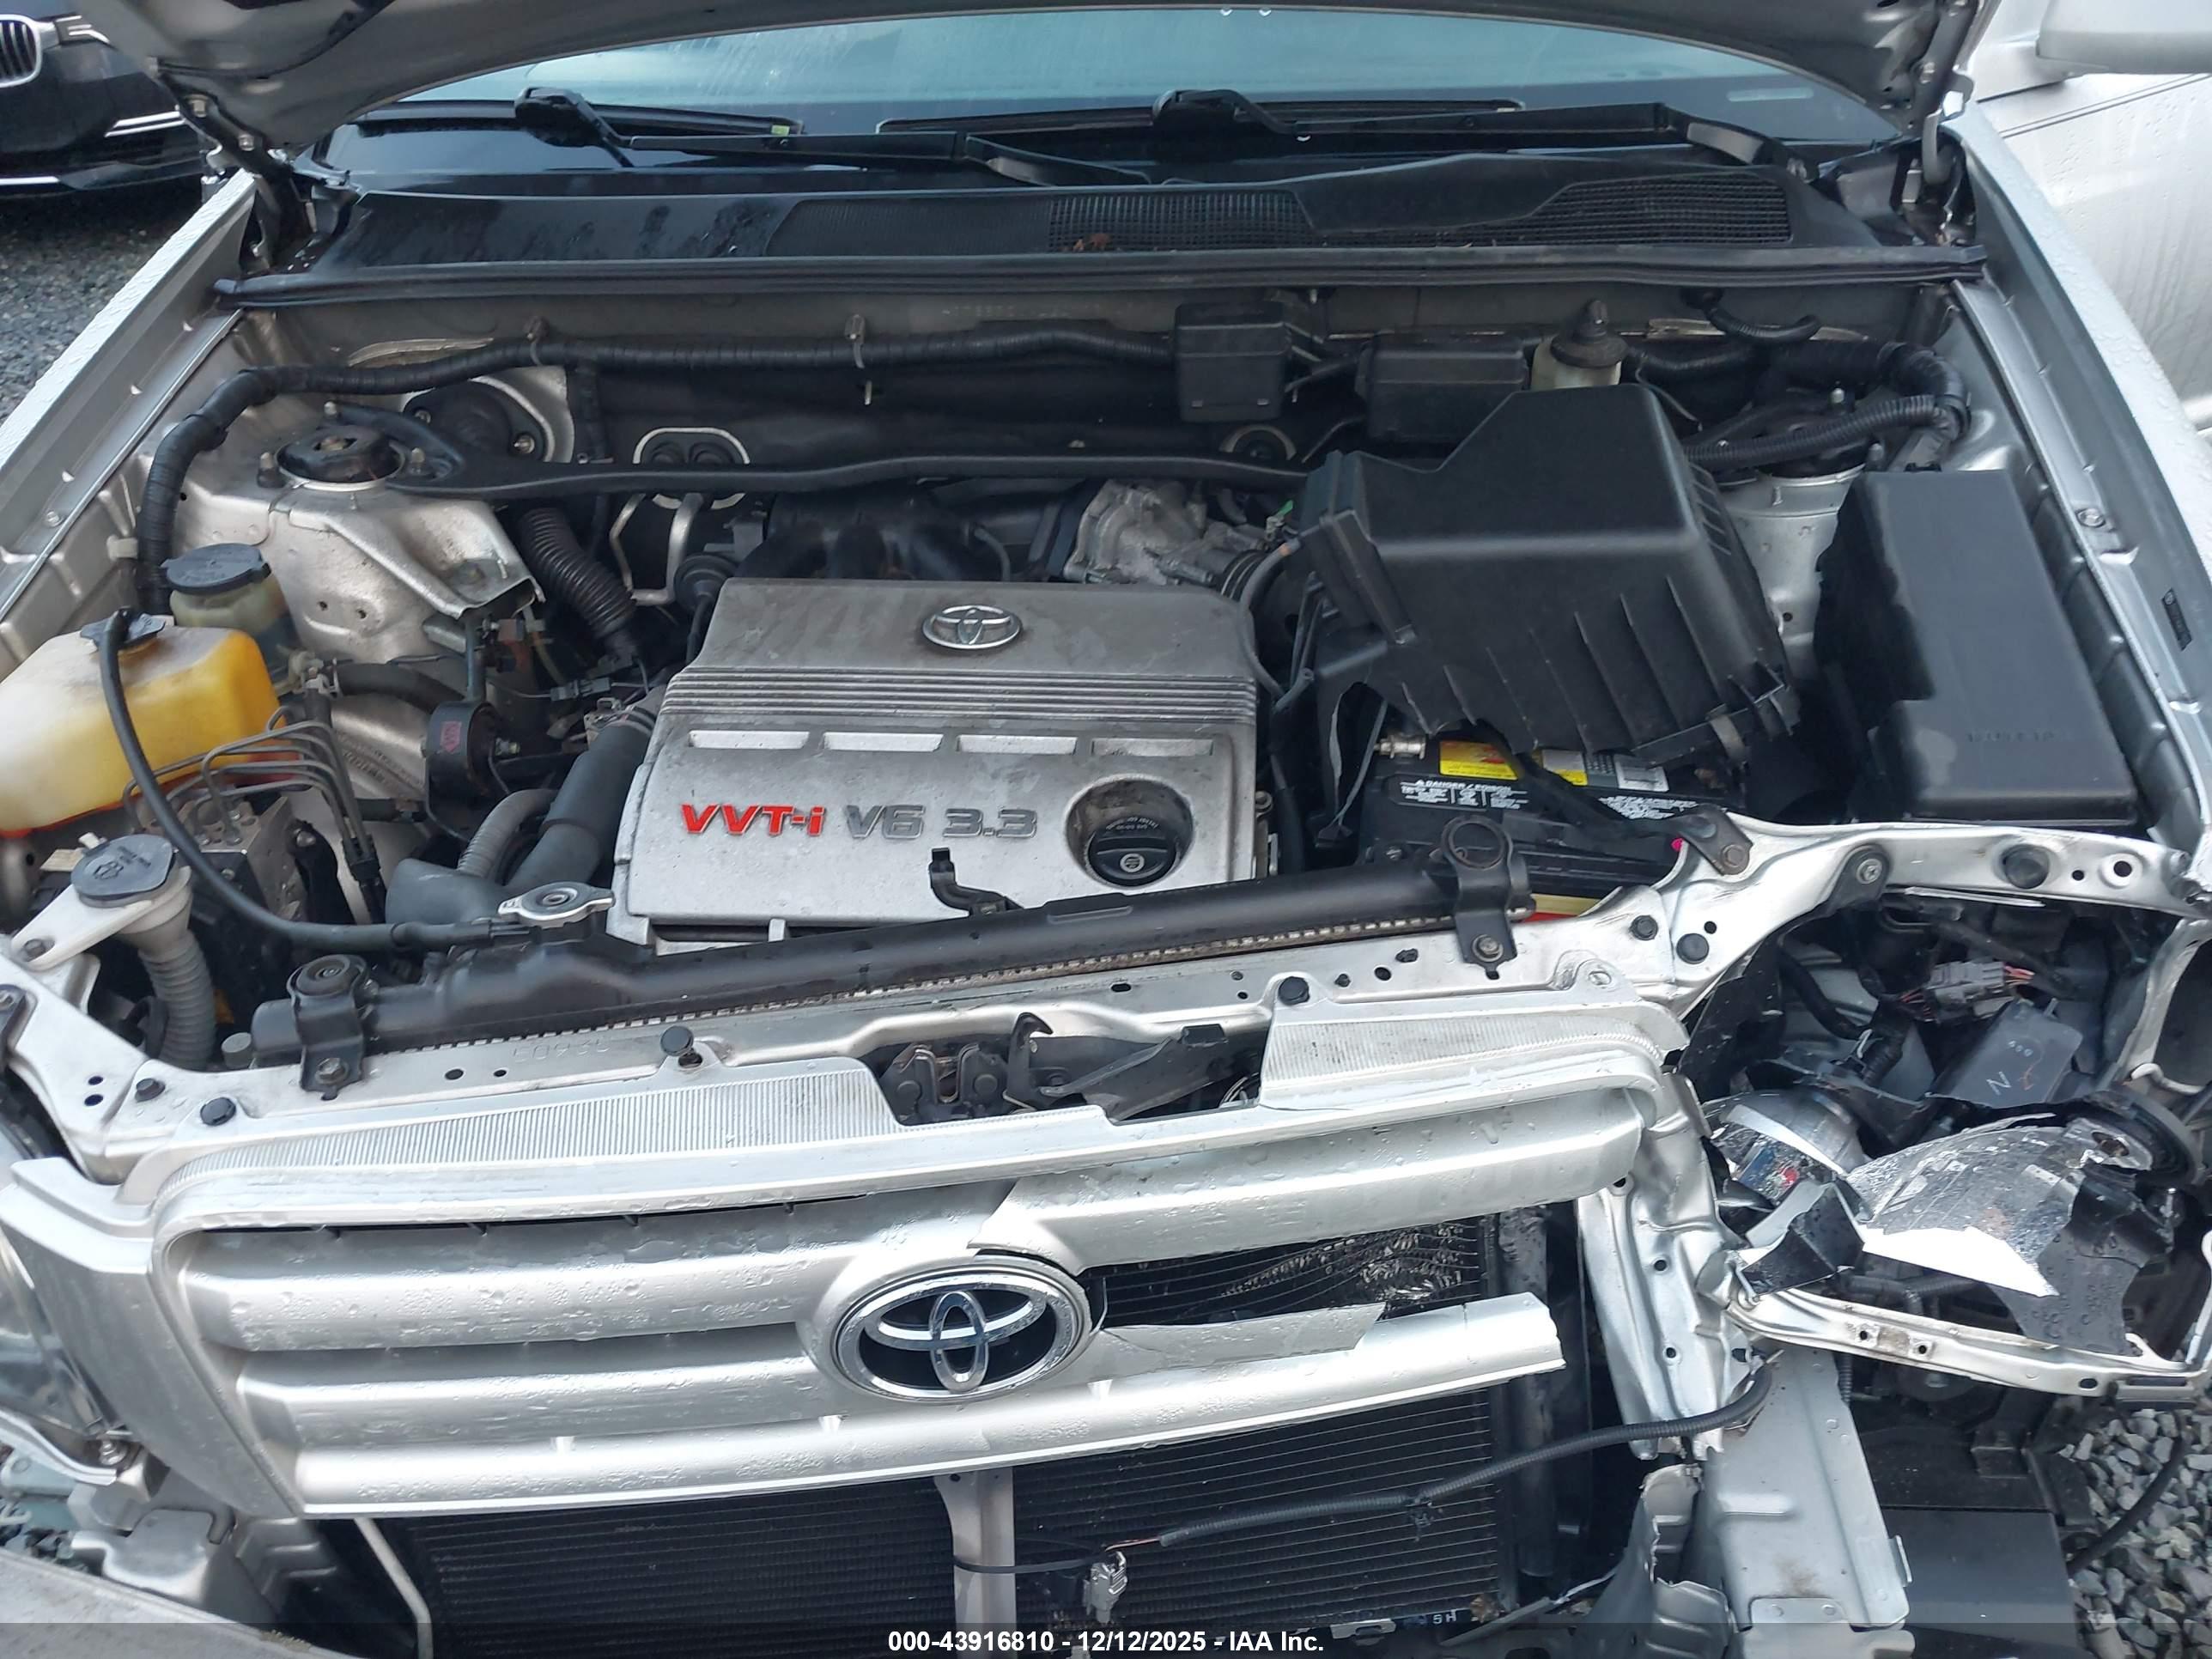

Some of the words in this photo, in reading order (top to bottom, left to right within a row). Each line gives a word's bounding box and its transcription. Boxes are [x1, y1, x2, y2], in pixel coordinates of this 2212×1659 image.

[681, 804, 826, 836] VVT-i
[842, 805, 924, 839] V6
[943, 808, 1037, 838] 3.3
